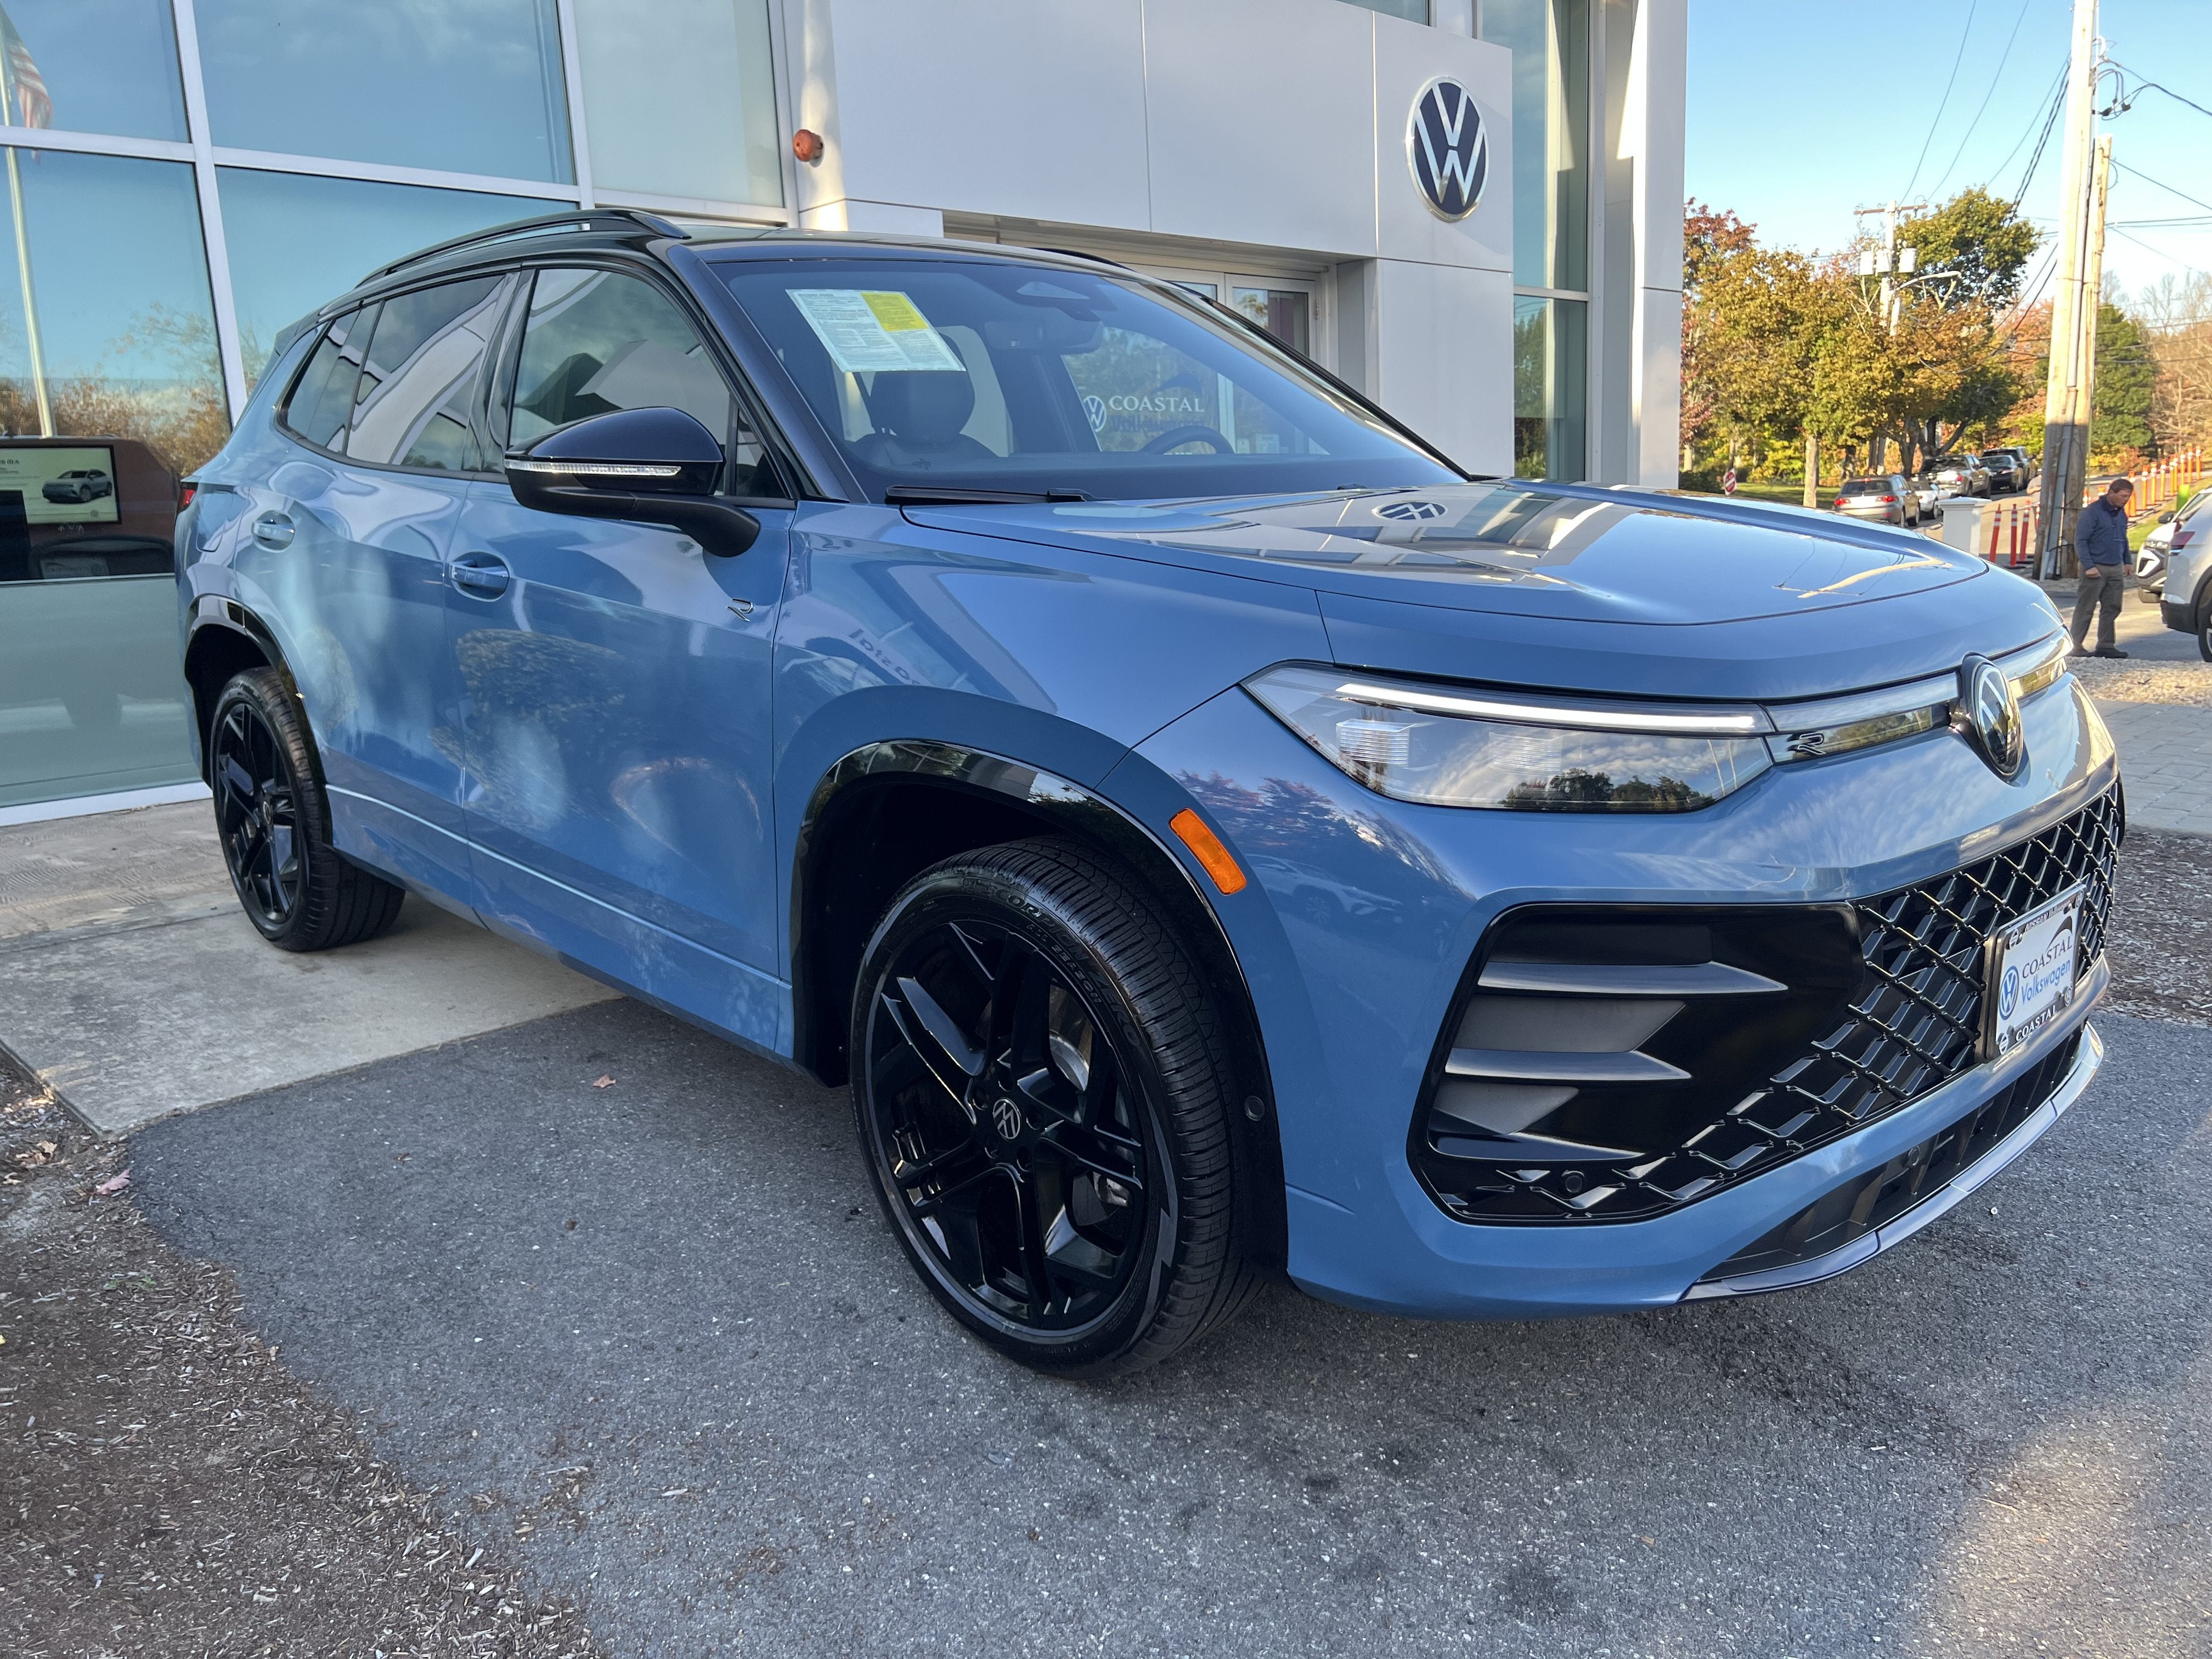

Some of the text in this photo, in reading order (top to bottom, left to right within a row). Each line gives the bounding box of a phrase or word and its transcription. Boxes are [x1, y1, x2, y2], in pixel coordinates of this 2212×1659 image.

[1405, 76, 1489, 223] VW
[1109, 396, 1205, 413] COASTAL
[1797, 732, 1826, 755] R
[2022, 936, 2073, 979] COASTAL
[2021, 960, 2071, 1005] Volkswagen
[2016, 1005, 2059, 1042] COASTAL
